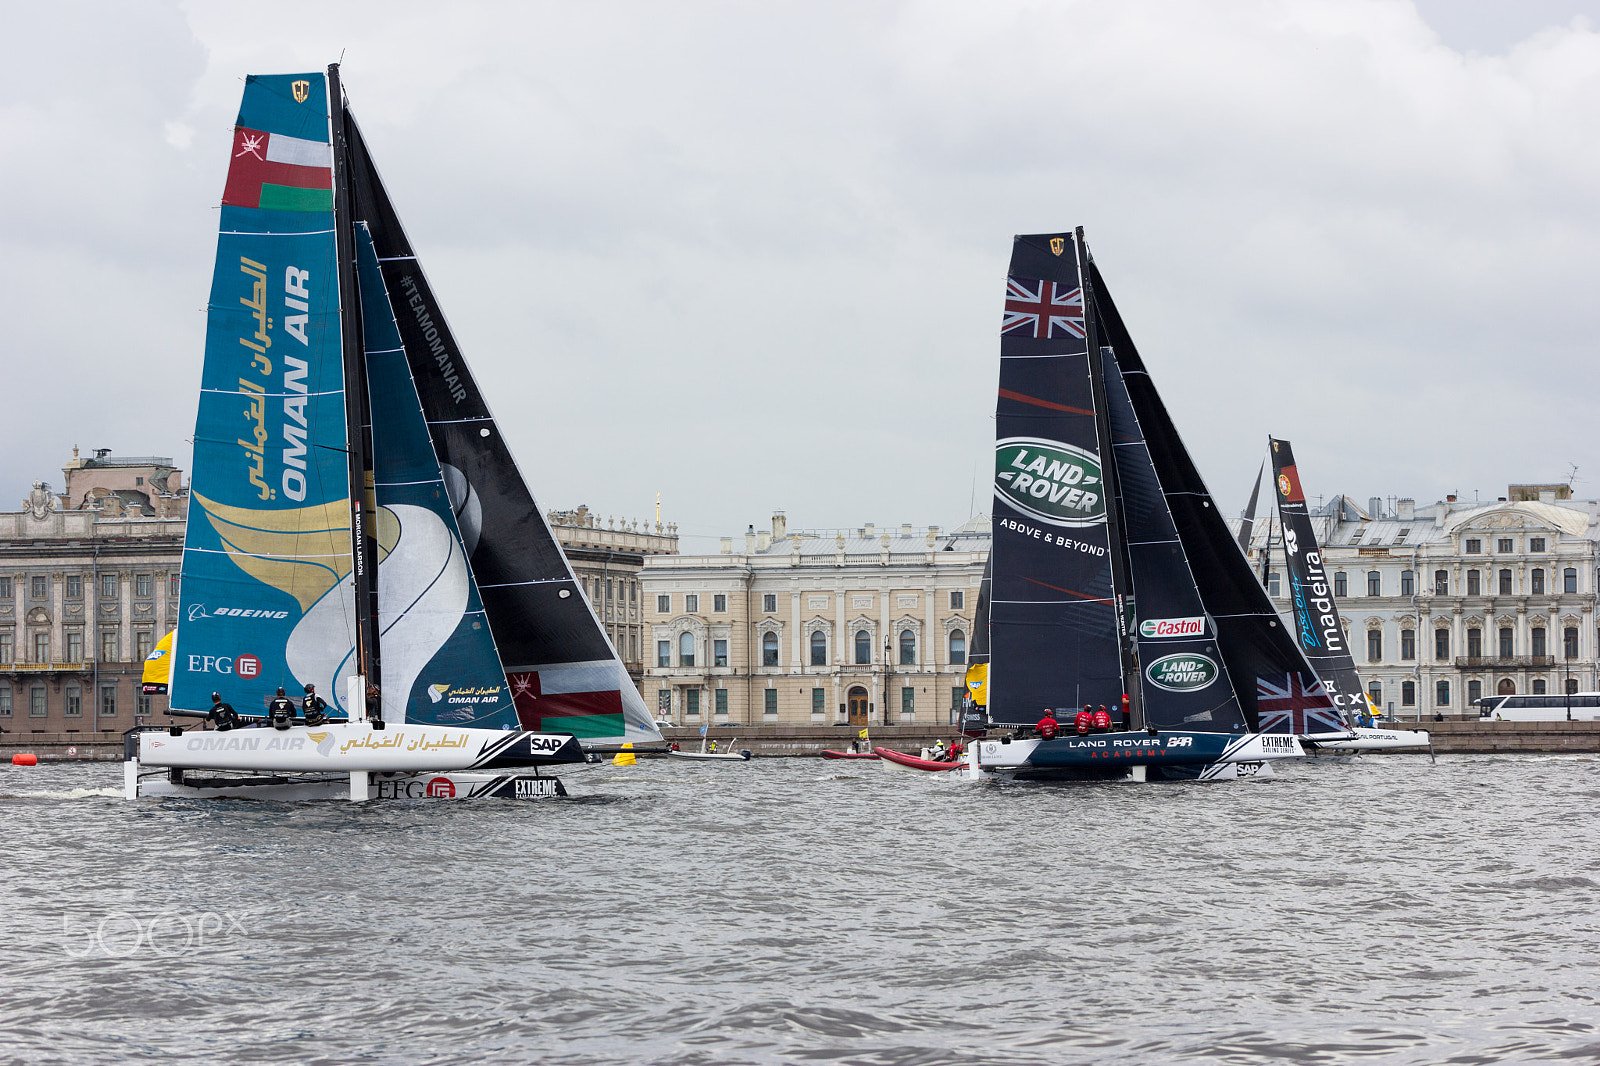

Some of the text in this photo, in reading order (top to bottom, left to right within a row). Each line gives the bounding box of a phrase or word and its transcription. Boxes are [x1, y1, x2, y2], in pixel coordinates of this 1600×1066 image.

[240, 256, 273, 376] الطيران
[400, 275, 467, 404] #TEAMOMANAIR
[282, 265, 309, 502] OMAN AIR
[1011, 449, 1084, 485] LAND
[1010, 472, 1098, 513] ROVER
[1000, 518, 1105, 557] ABOVE & BEYOND
[356, 546, 364, 576] LARSON
[1306, 552, 1342, 651] madeira
[213, 607, 288, 619] BOEING
[1157, 619, 1202, 635] Castrol
[188, 655, 233, 674] EFG
[1162, 661, 1196, 672] LAND
[1165, 672, 1207, 682] ROVER
[187, 737, 306, 751] OMAN AIR
[407, 734, 470, 752] الطيران
[531, 737, 562, 751] SAP
[1069, 739, 1161, 748] LAND ROVER
[1261, 736, 1294, 748] EXTREME
[1091, 750, 1167, 759] ACADEMY
[1237, 764, 1259, 776] SAP
[378, 780, 424, 799] EFG
[515, 779, 558, 795] EXTREME
